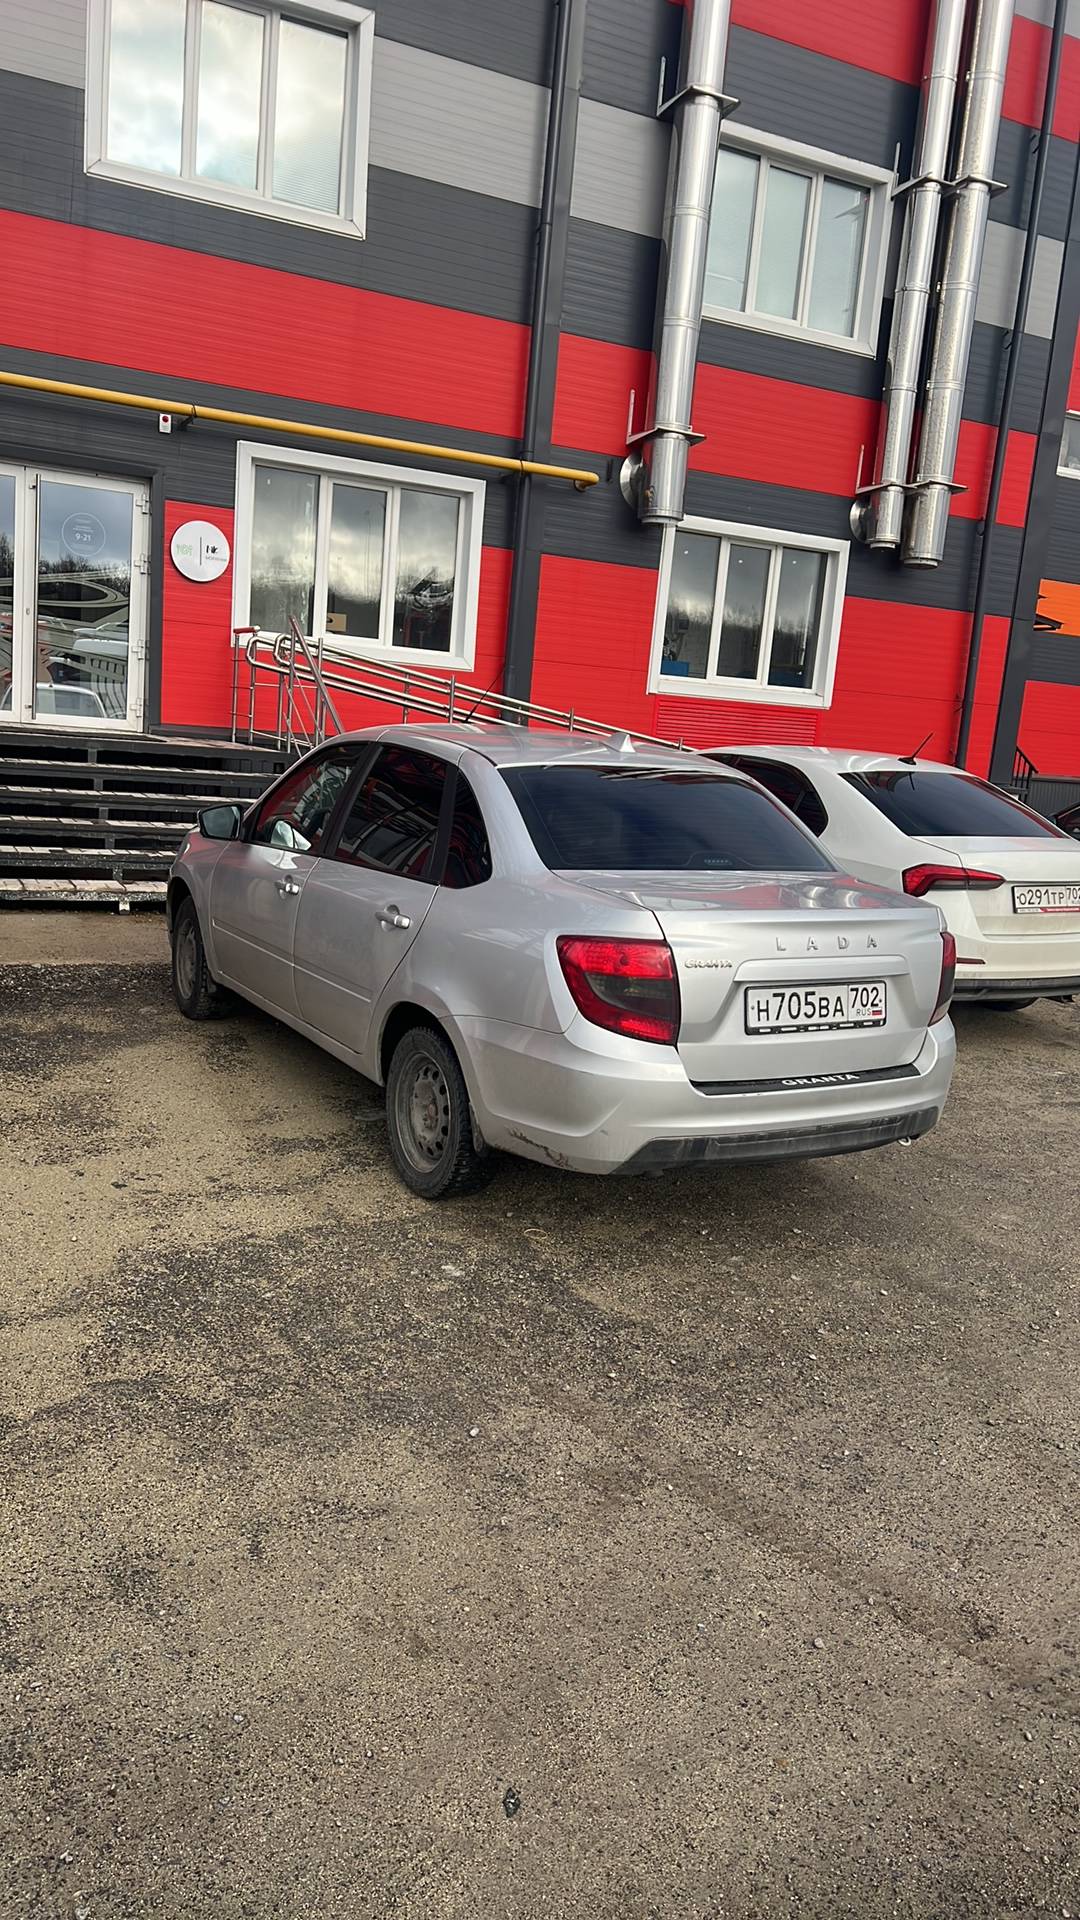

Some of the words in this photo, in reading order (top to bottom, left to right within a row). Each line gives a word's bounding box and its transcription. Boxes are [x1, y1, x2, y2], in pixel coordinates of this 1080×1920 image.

[776, 935, 878, 951] LADA
[684, 958, 733, 969] GRANTA
[850, 987, 879, 1008] 702
[856, 1008, 872, 1017] RUS
[781, 1073, 860, 1086] GRANTA
